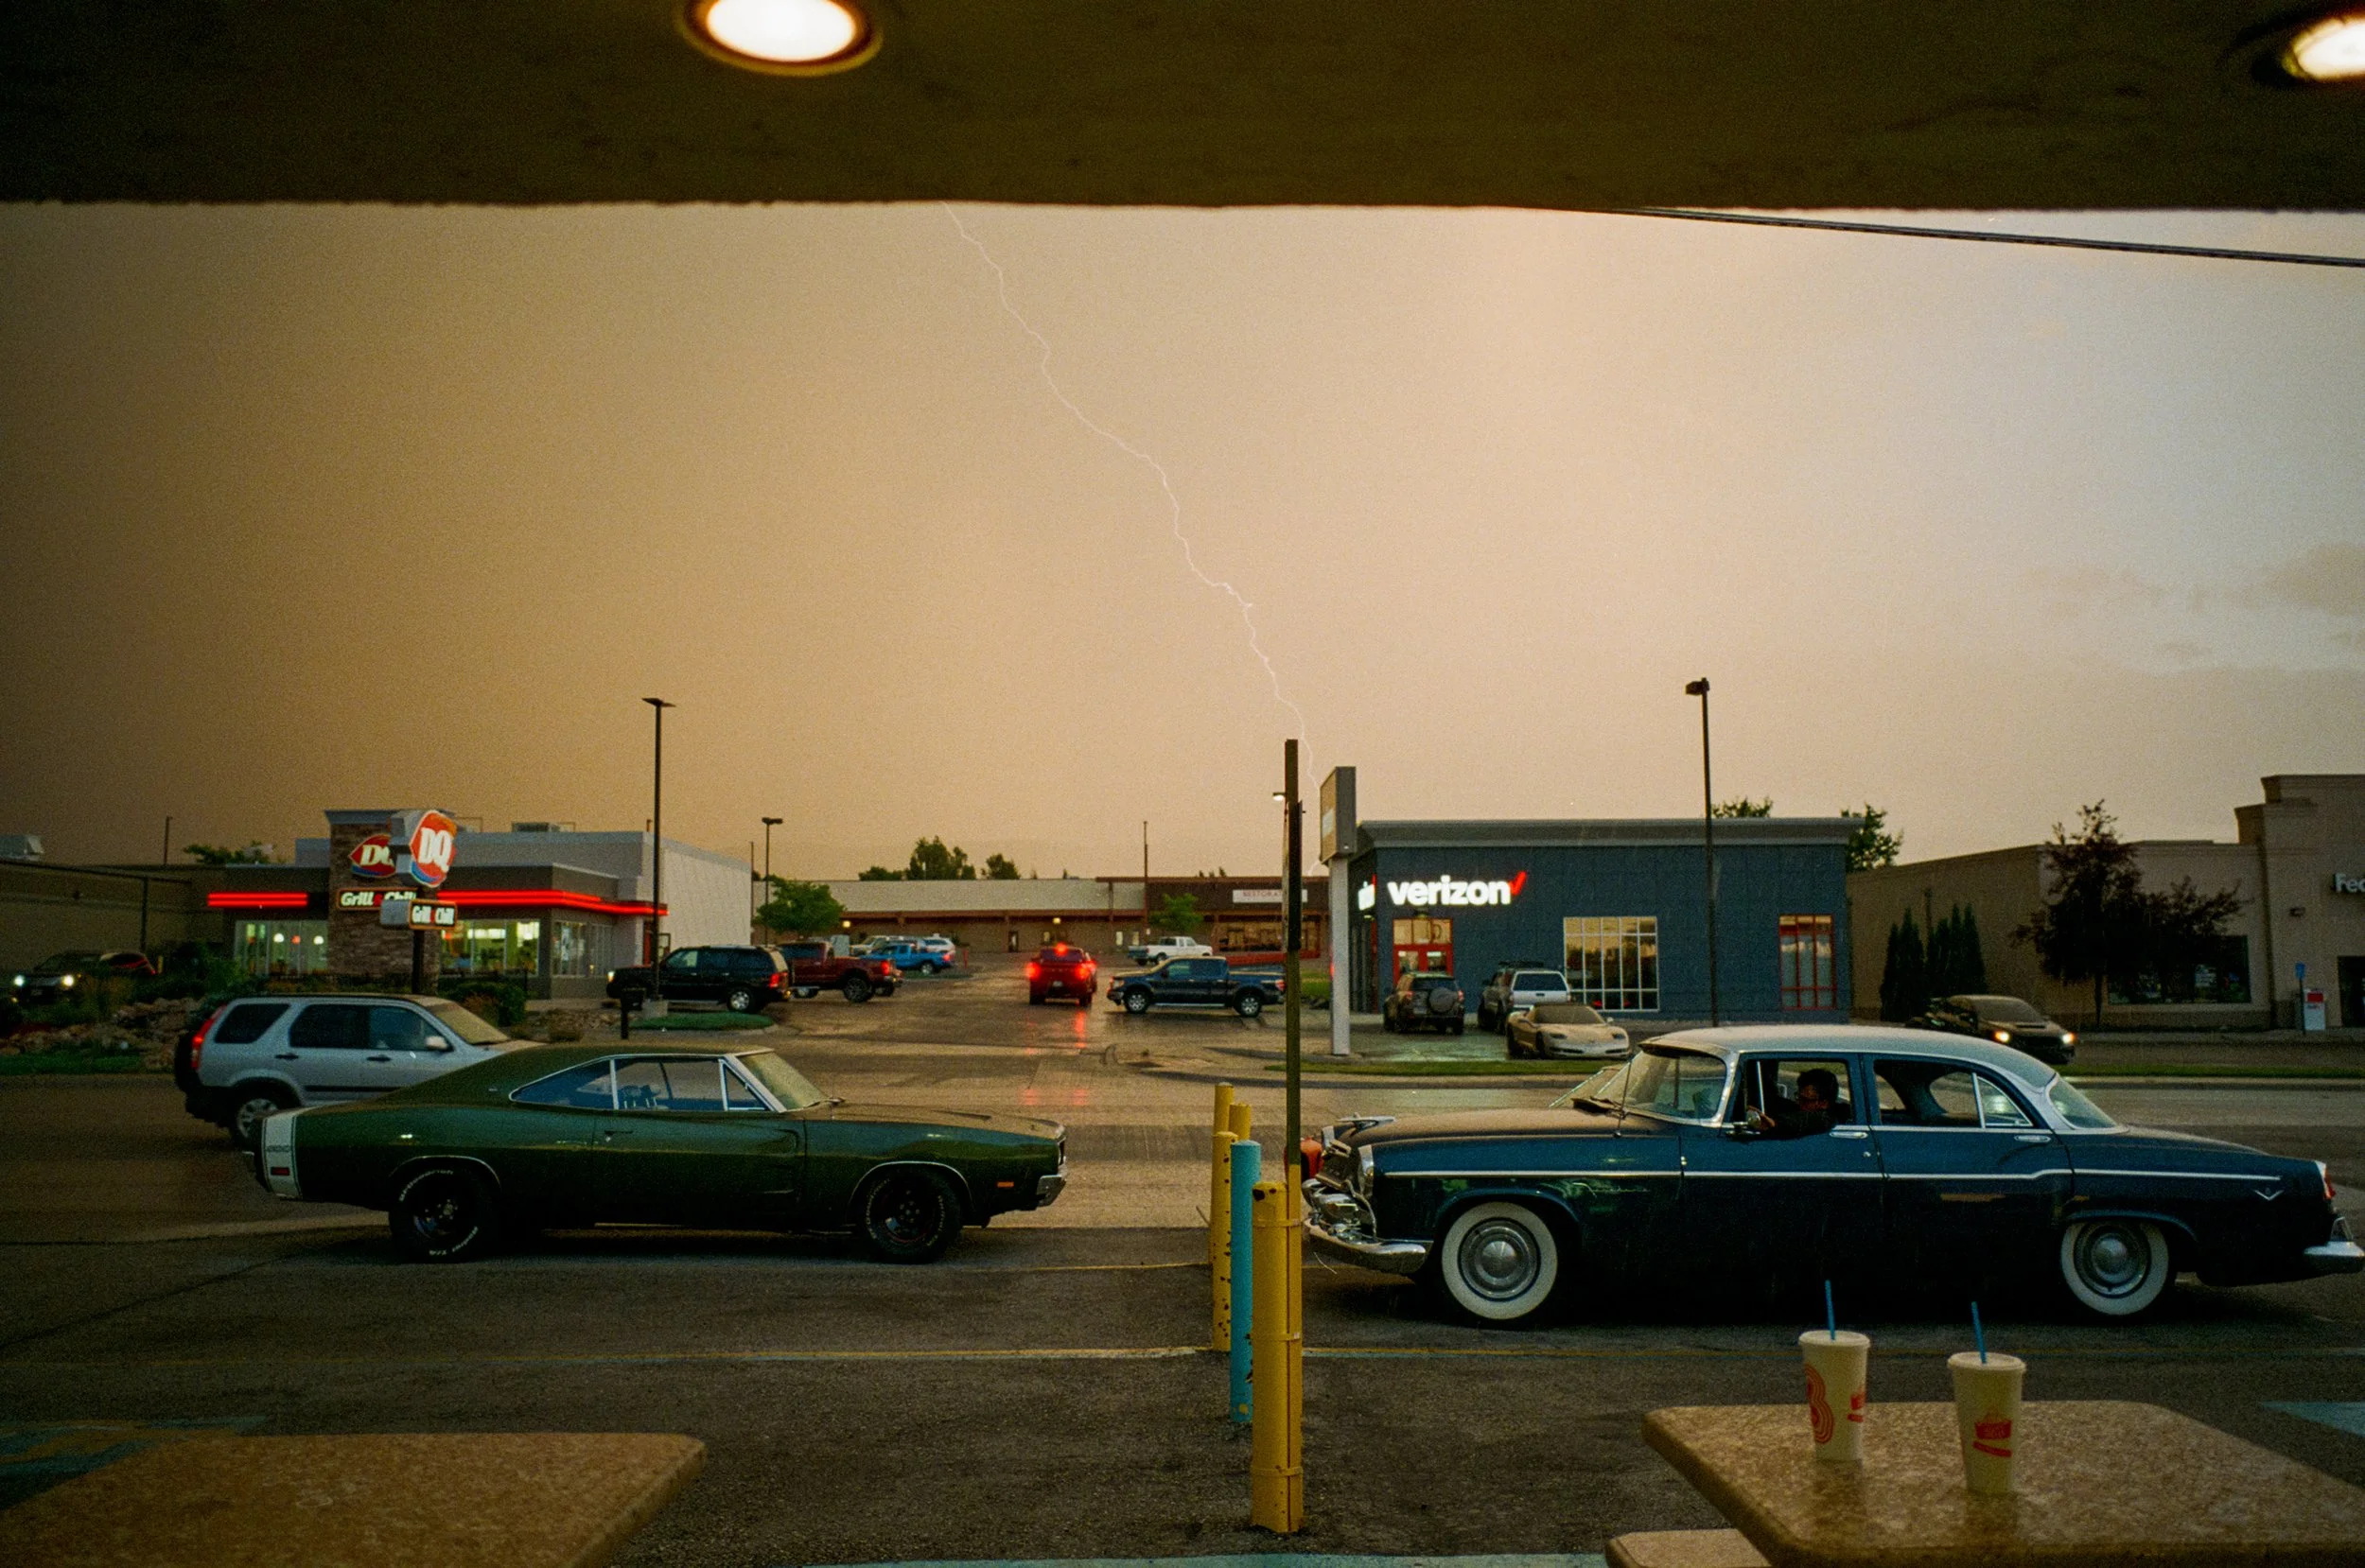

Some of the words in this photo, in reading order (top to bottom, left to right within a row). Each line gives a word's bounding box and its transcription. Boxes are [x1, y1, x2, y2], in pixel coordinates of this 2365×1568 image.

[418, 828, 453, 873] DQ
[341, 891, 375, 906] Grill
[1387, 875, 1512, 906] verizon
